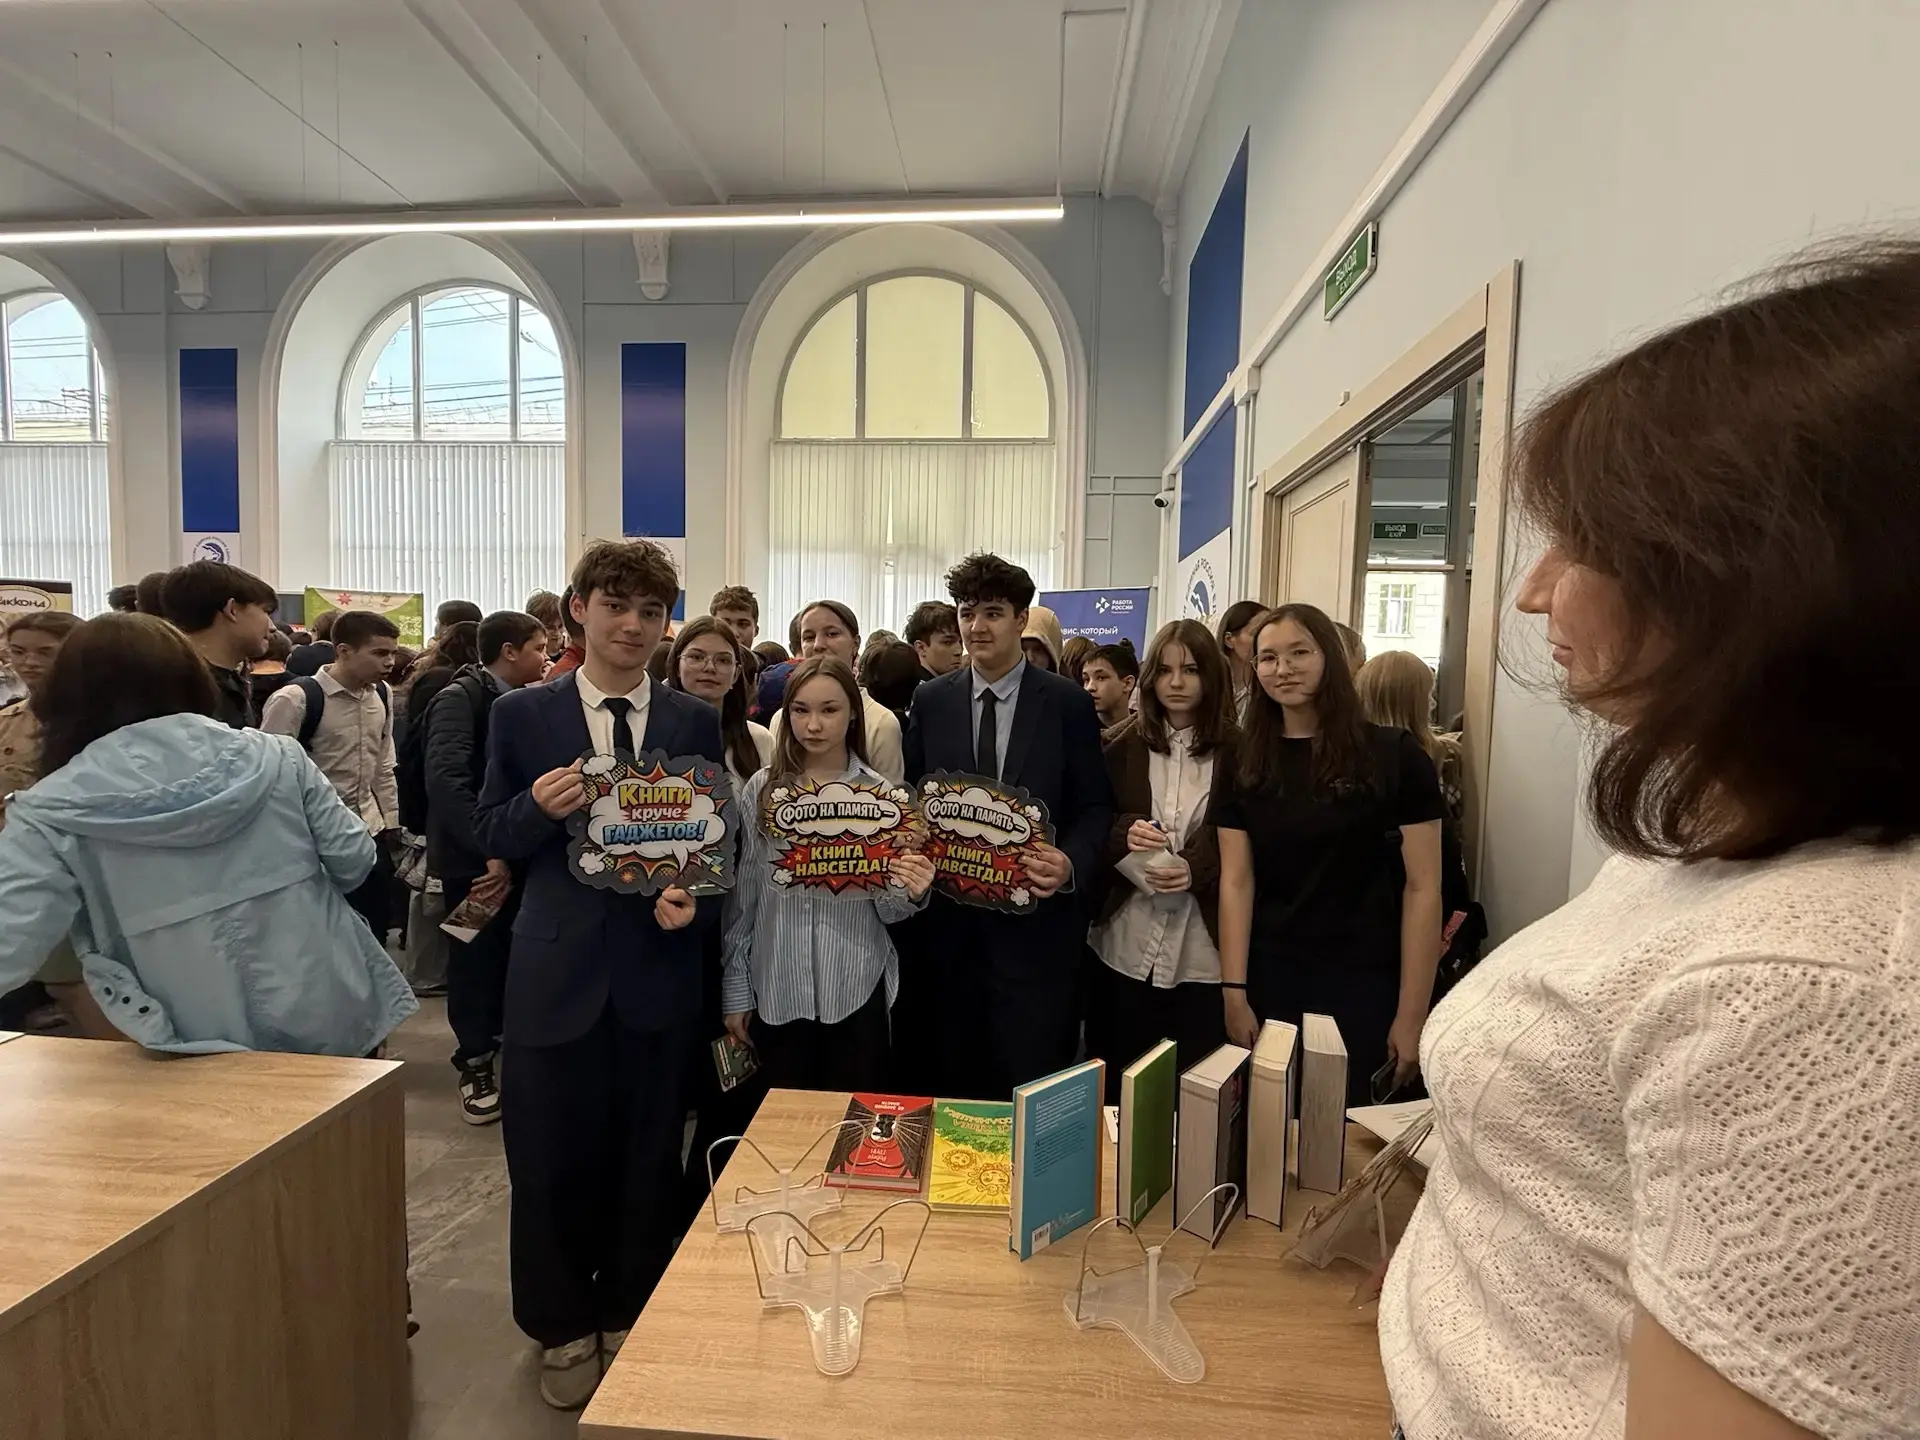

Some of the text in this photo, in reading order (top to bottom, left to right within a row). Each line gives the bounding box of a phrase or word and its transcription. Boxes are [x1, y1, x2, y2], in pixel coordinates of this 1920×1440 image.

[1384, 524, 1407, 533] ВЫХОД
[1061, 625, 1119, 636] вис, который
[631, 806, 683, 822] круче
[782, 802, 818, 823] ФОТО
[820, 803, 836, 817] НА
[929, 799, 960, 817] ФОТО
[960, 804, 974, 820] НА
[602, 820, 708, 845] ГАДЖЕТОВ!
[810, 844, 864, 861] КНИГА
[946, 843, 993, 867] КНИГА
[795, 855, 890, 877] НАВСЕГДА!
[931, 856, 1013, 886] НАВСЕГДА!
